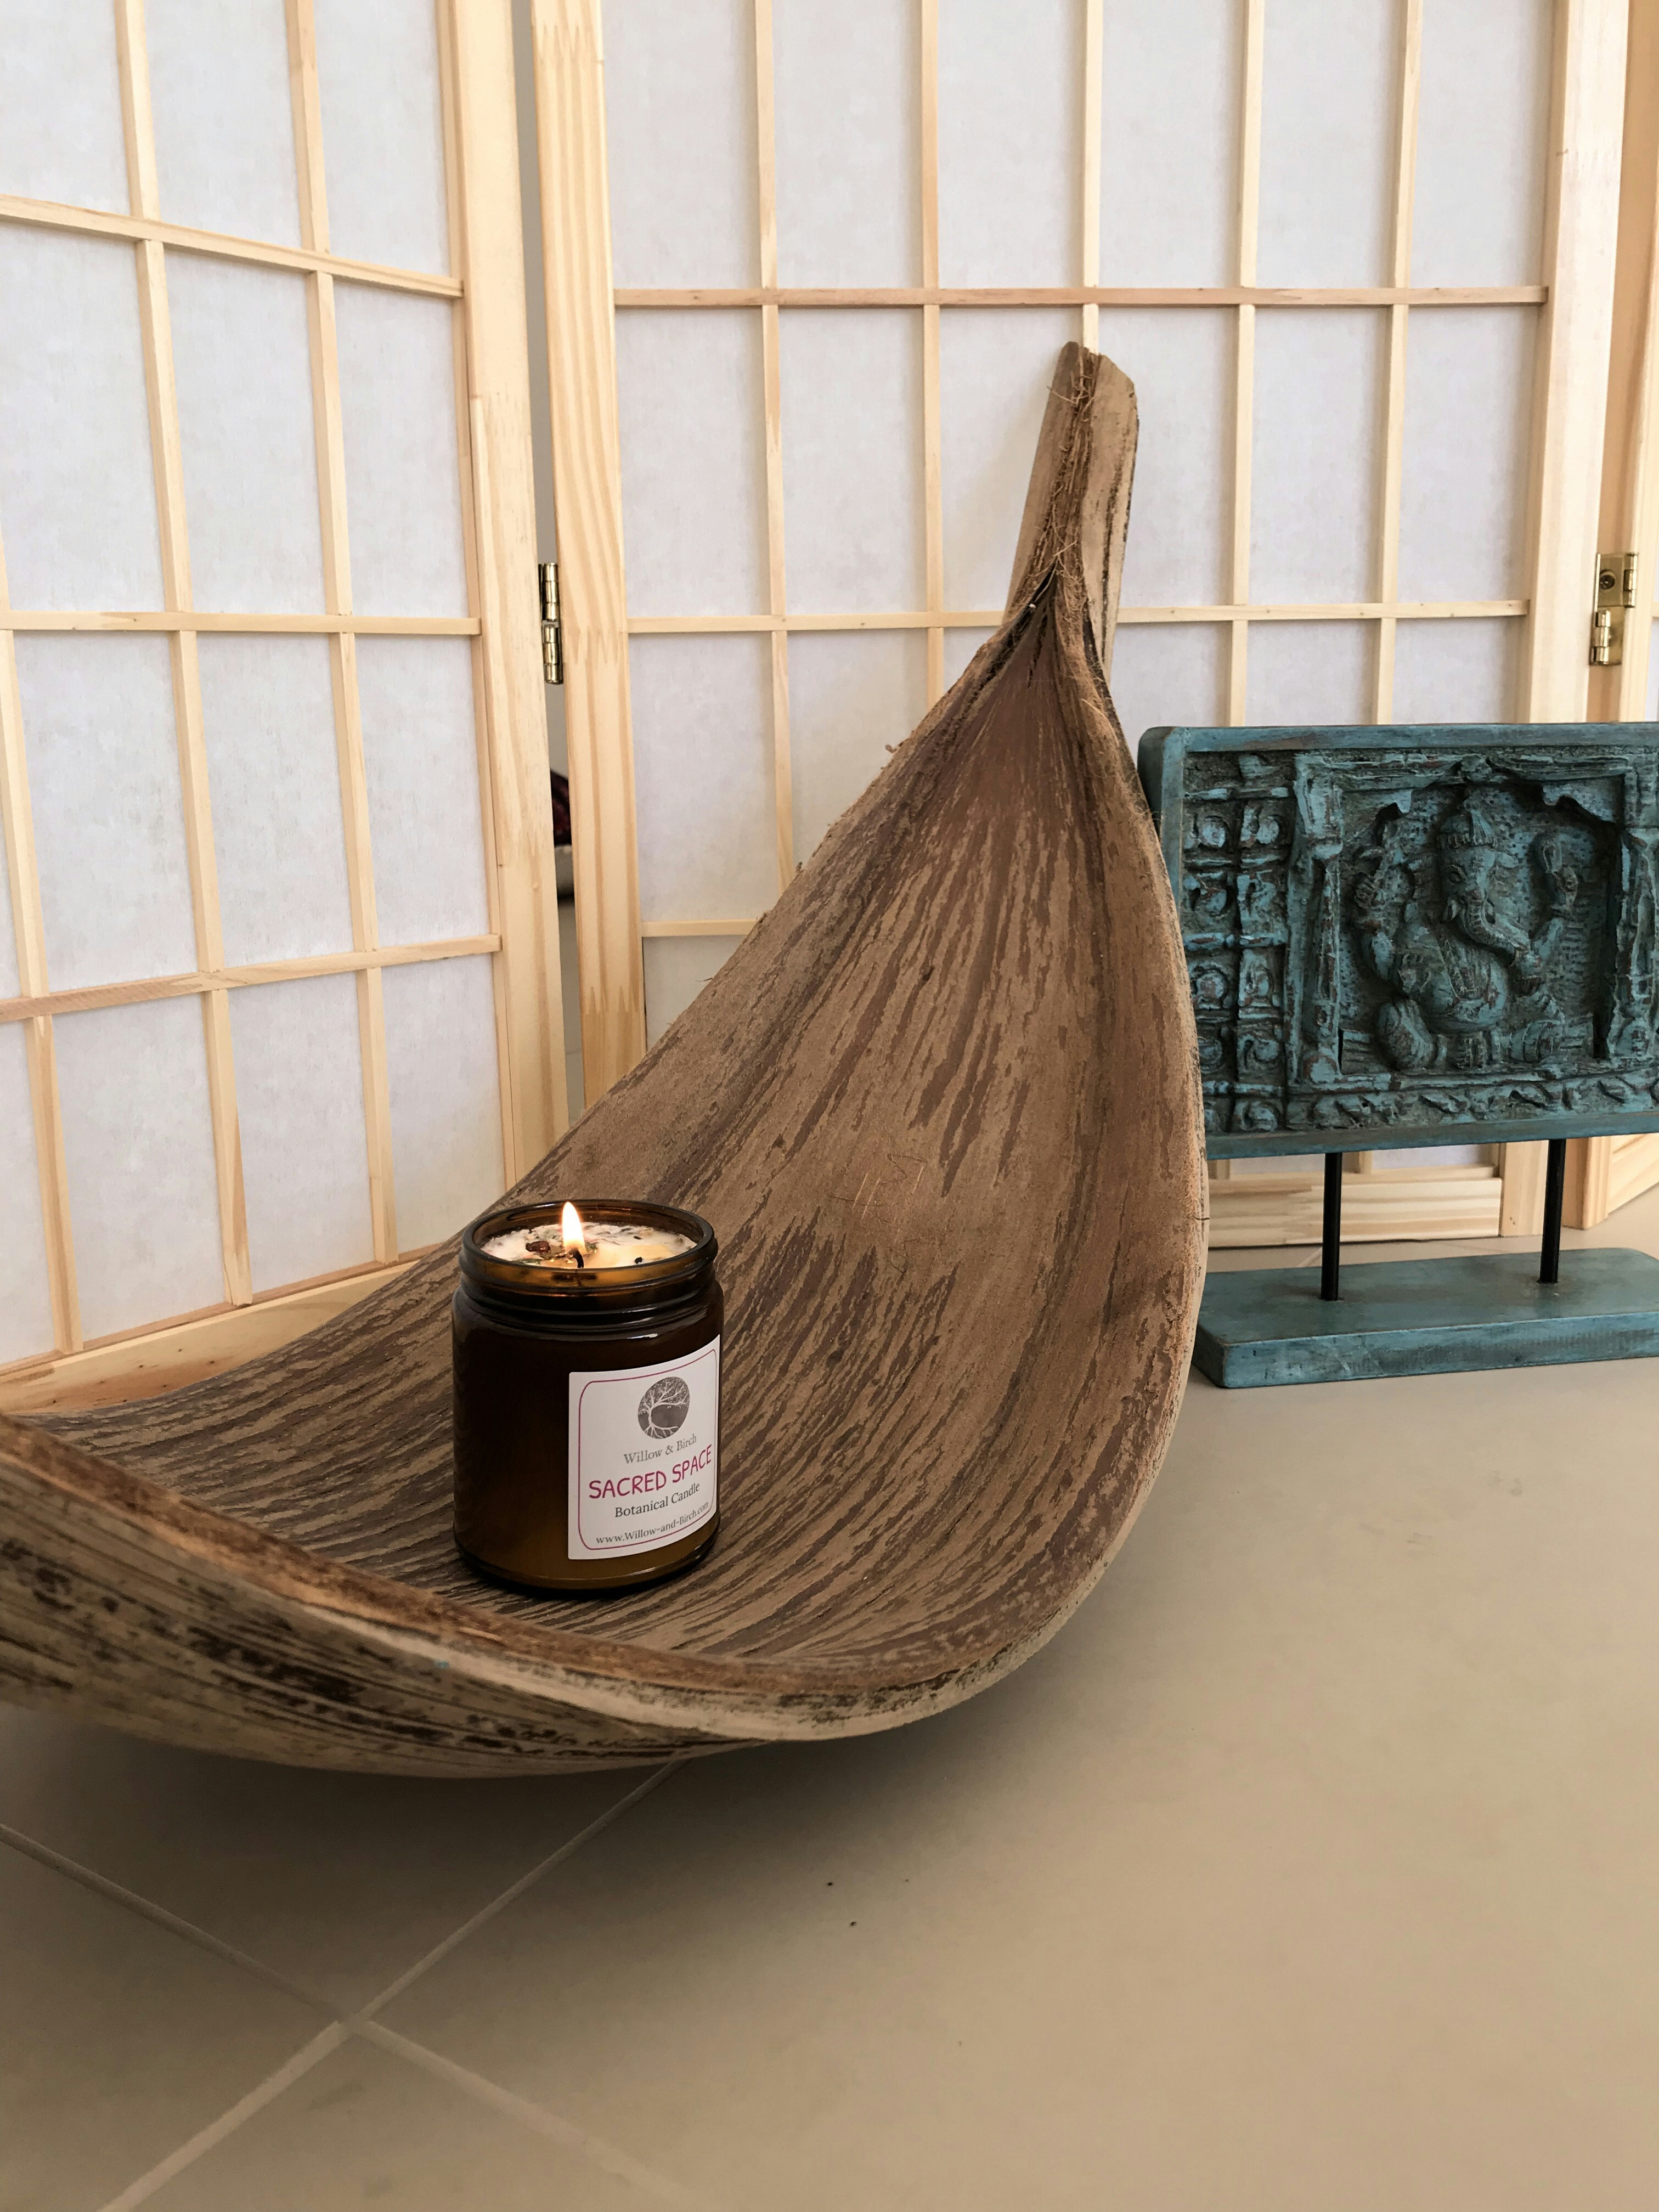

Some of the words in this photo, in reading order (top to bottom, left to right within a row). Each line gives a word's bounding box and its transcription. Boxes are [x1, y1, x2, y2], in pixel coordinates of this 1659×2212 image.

[624, 1449, 662, 1464] Willow
[665, 1444, 673, 1455] &
[676, 1434, 697, 1451] Birch
[589, 1471, 667, 1499] SACRED
[672, 1444, 712, 1483] SPACE
[615, 1496, 668, 1518] Botanical
[671, 1482, 700, 1503] Candle
